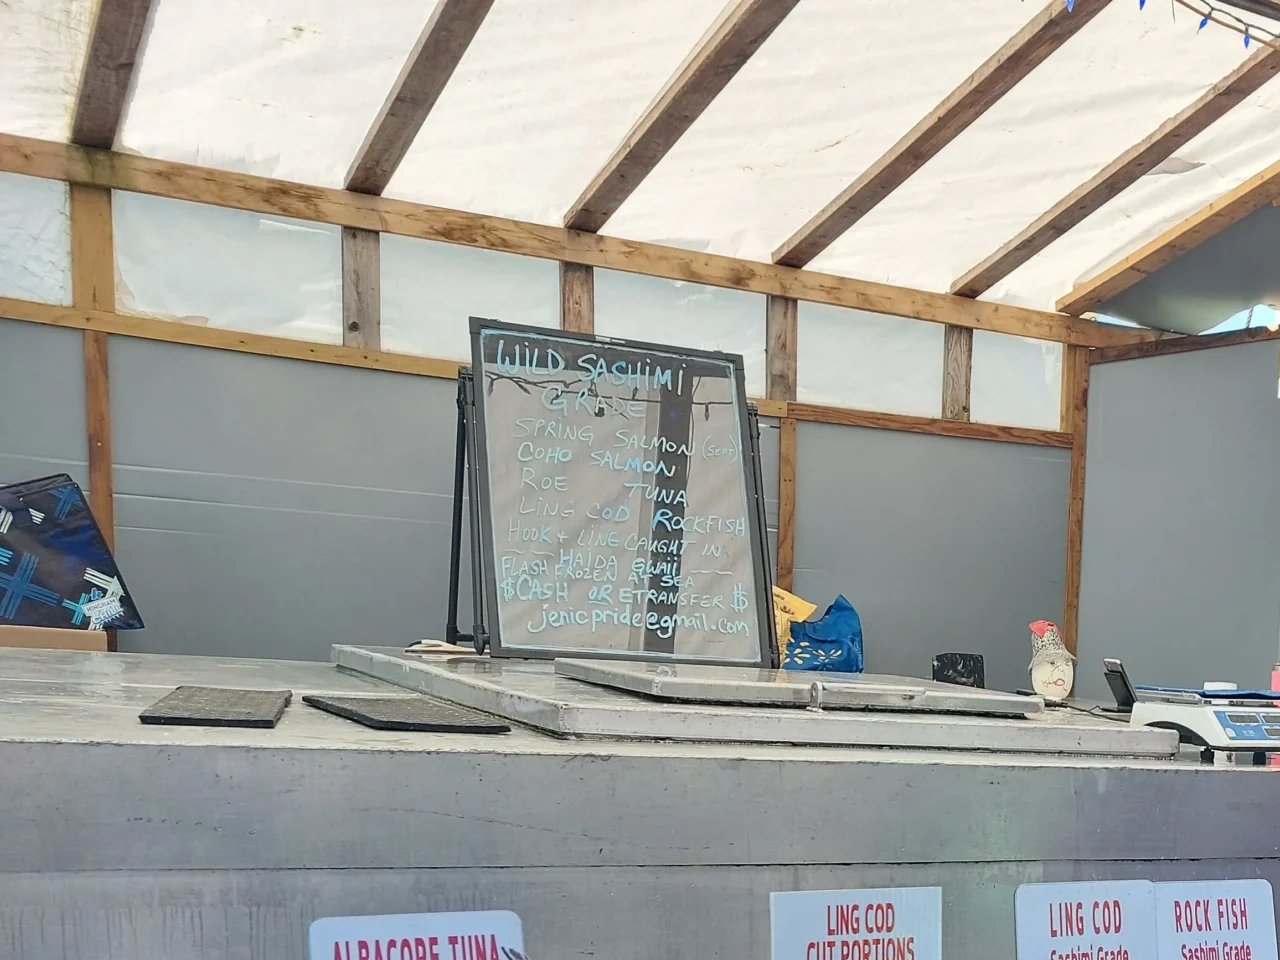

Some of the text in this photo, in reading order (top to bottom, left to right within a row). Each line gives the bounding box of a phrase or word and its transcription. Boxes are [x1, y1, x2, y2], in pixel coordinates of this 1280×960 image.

[542, 385, 645, 418] GRADE
[518, 442, 676, 477] COHO SALMON
[614, 429, 695, 456] SALMON
[520, 467, 688, 507] ROE TUNA
[586, 502, 630, 522] COD
[652, 508, 745, 537] ROCKFISH
[508, 517, 552, 544] HOOK
[624, 534, 696, 554] CAUGHT
[702, 544, 720, 557] IN
[501, 556, 694, 588] FLASH FROZEN AT SEA
[588, 585, 613, 604] OR
[619, 588, 724, 609] ETRANSFER
[730, 582, 748, 613] $
[827, 903, 895, 936] LING COD
[1049, 900, 1122, 938] LING COD
[1174, 898, 1248, 932] ROCK FISH
